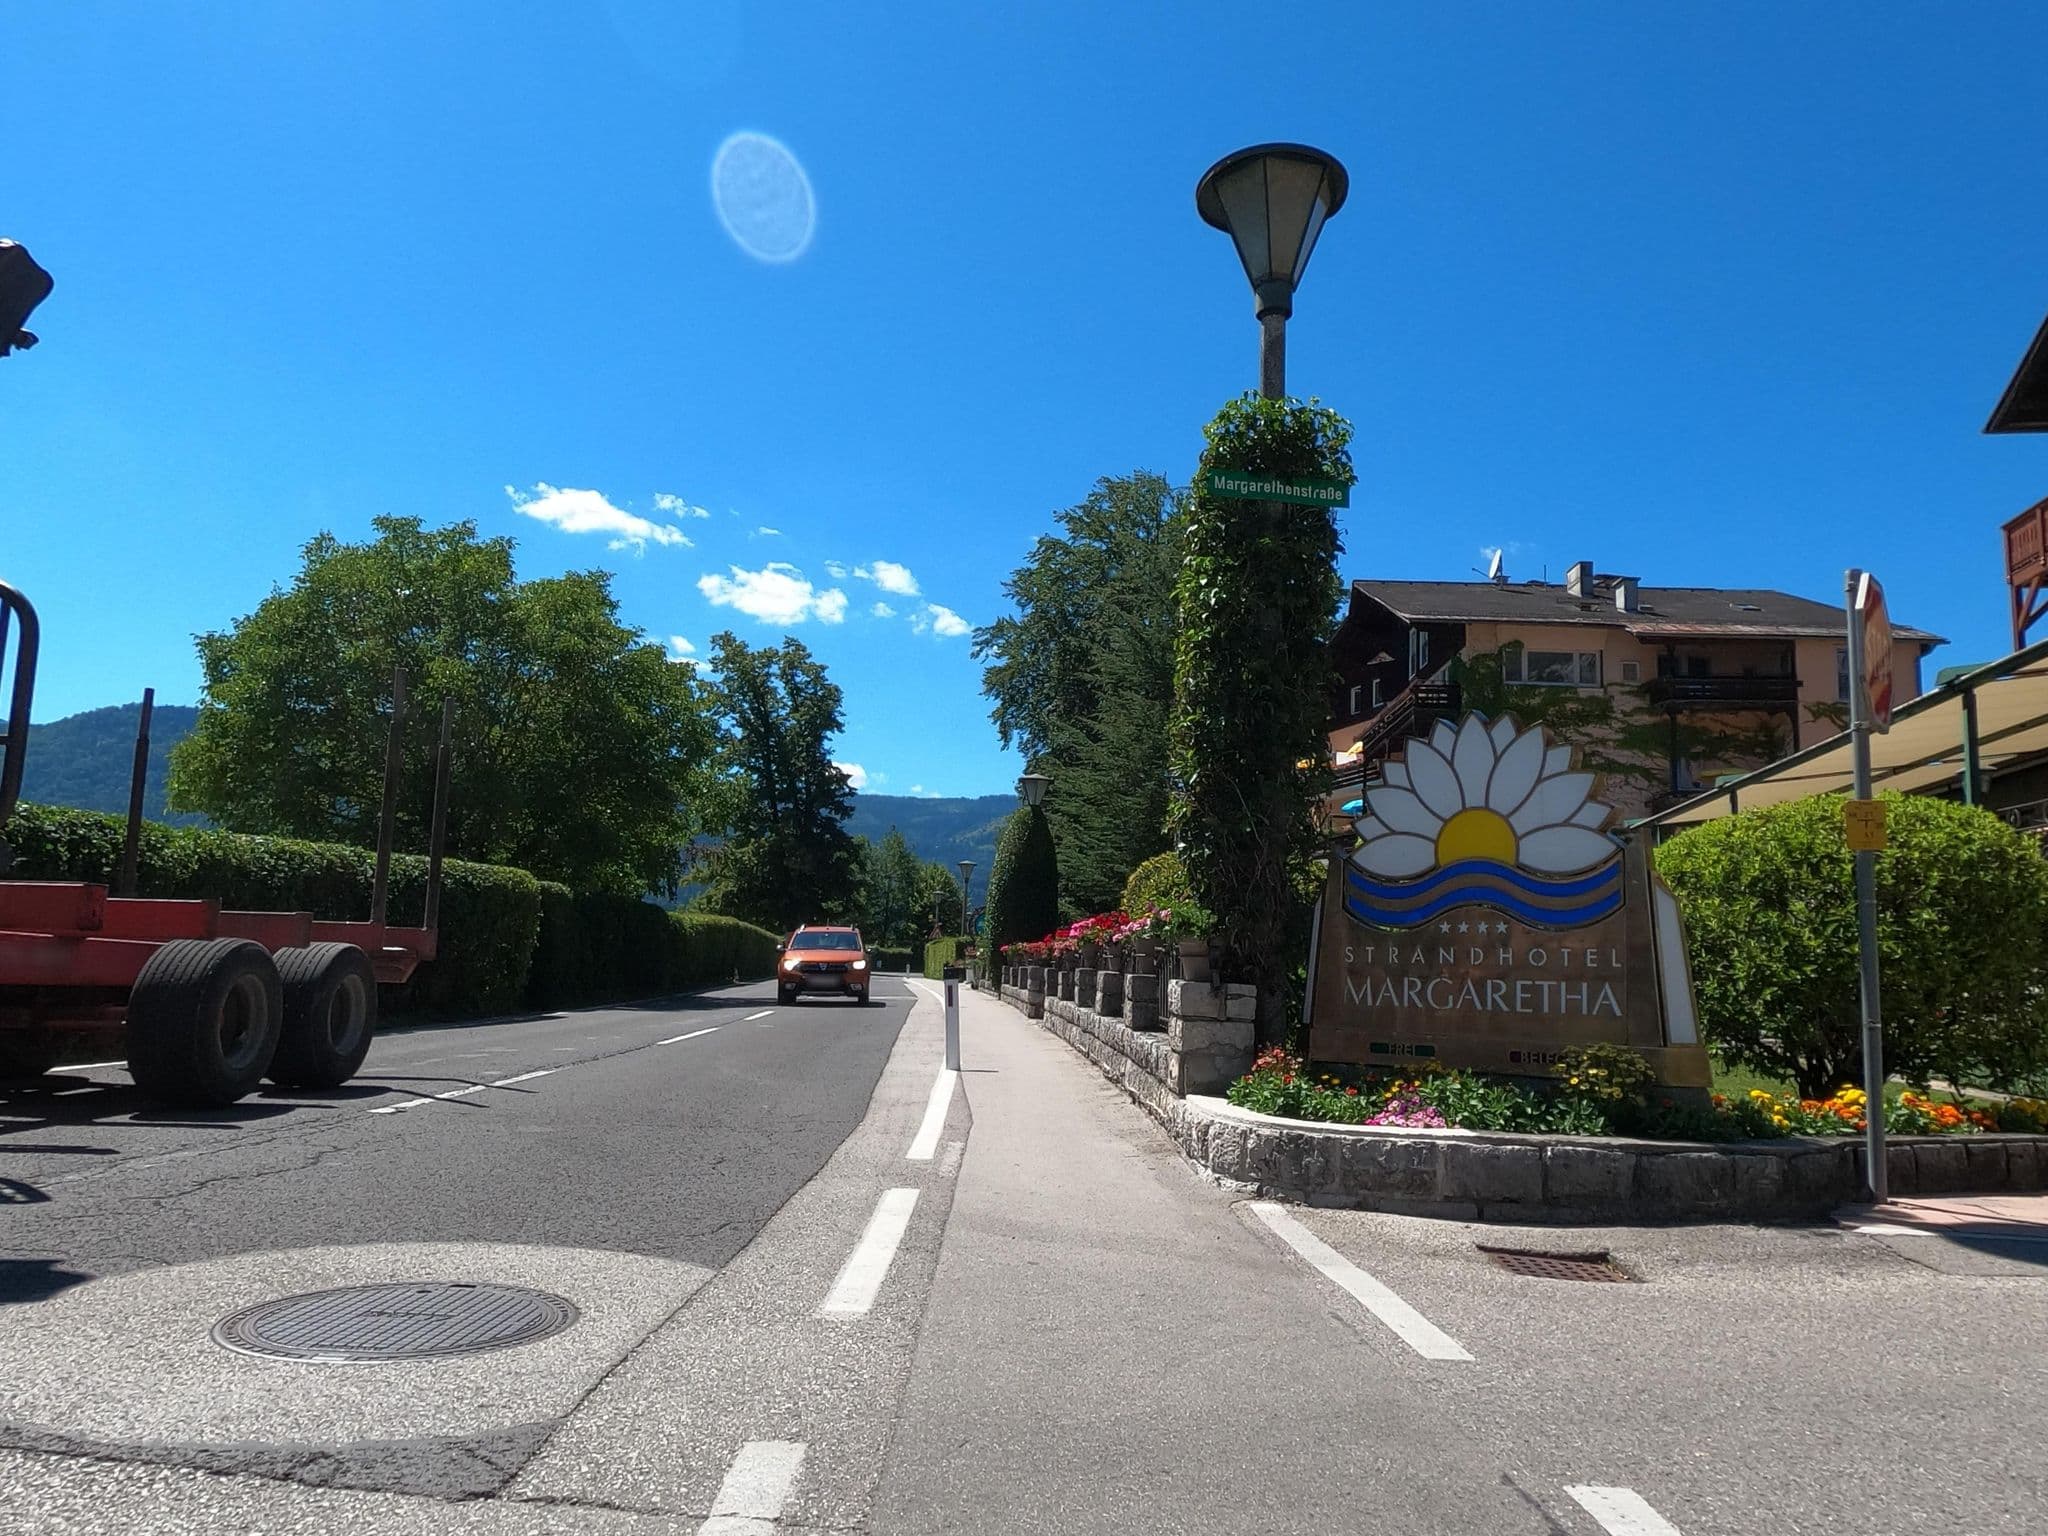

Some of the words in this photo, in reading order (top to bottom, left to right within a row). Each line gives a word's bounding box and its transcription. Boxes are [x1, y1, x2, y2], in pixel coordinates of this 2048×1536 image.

[1213, 475, 1343, 500] Margarethenstraße
[1344, 946, 1622, 968] STRANDHOTEL
[1344, 976, 1623, 1017] MARGARETHA
